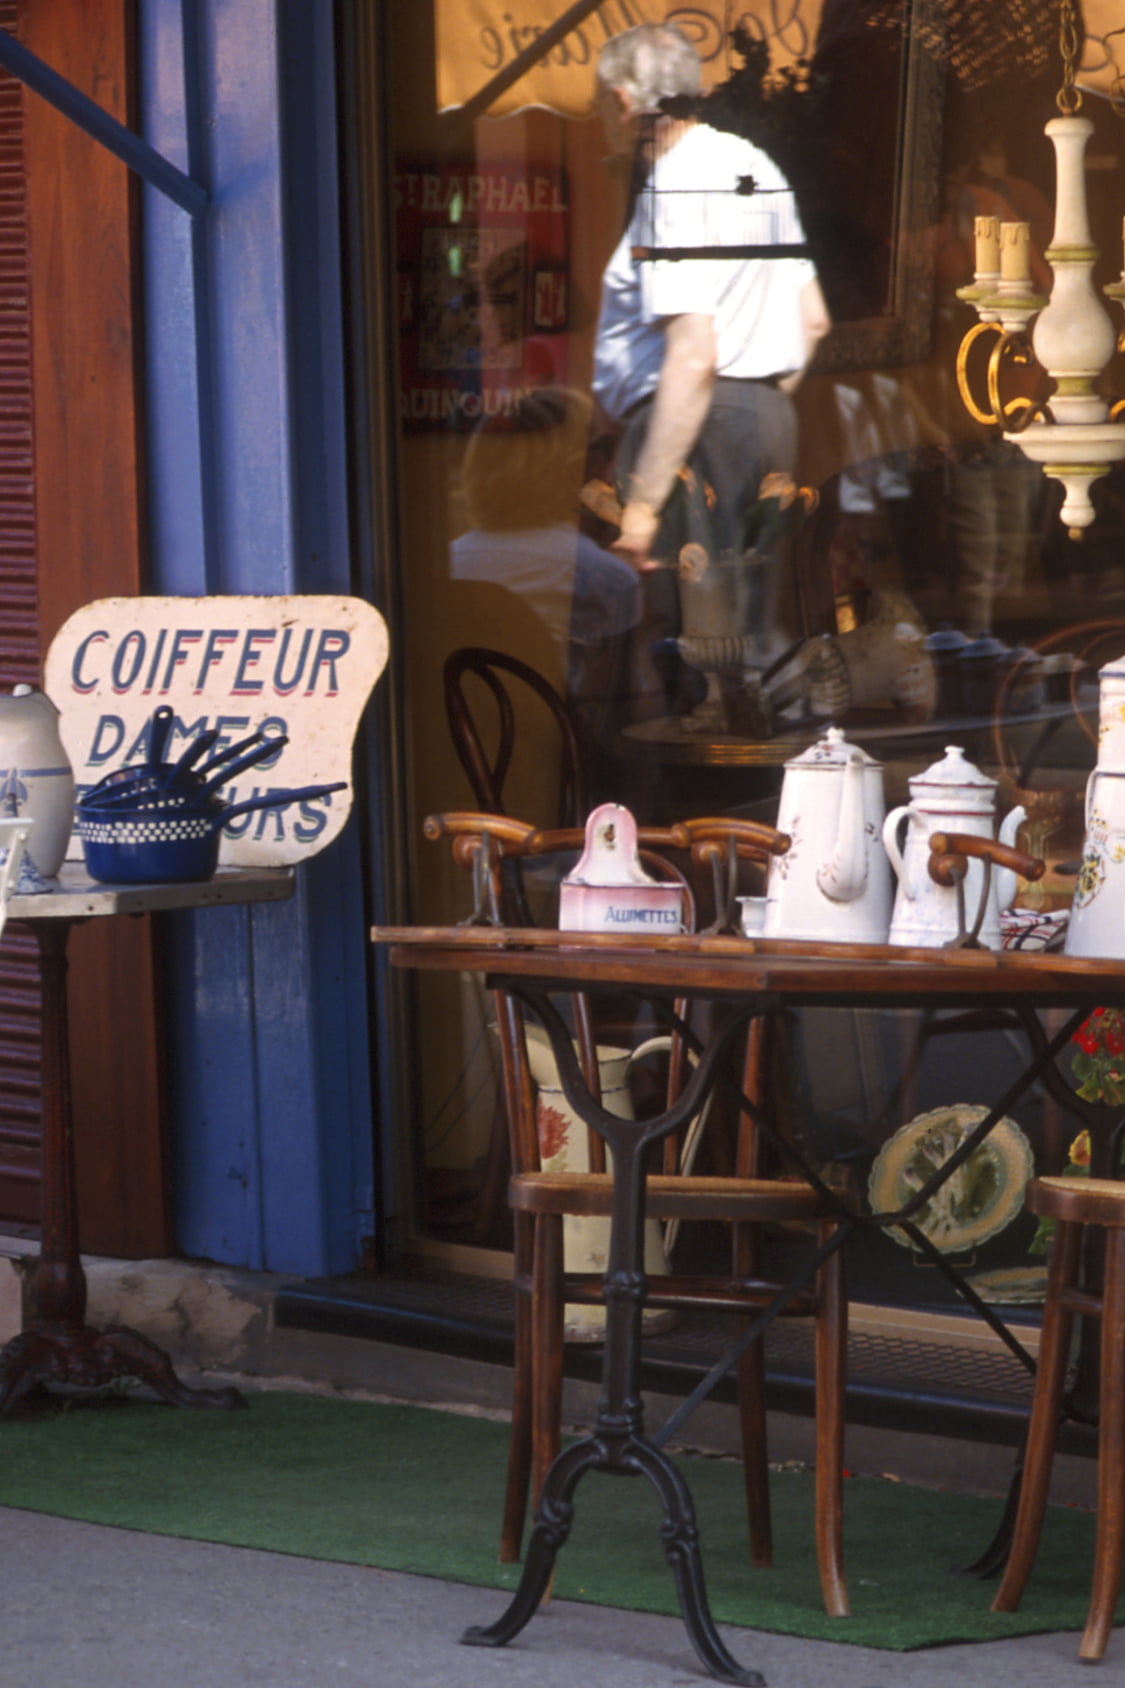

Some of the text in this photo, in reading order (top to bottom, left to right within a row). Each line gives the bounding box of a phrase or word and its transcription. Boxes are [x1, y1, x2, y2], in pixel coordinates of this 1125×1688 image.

[421, 173, 568, 212] RAPHAEL
[71, 627, 351, 696] COIFFEUR
[85, 714, 289, 771] DAMES
